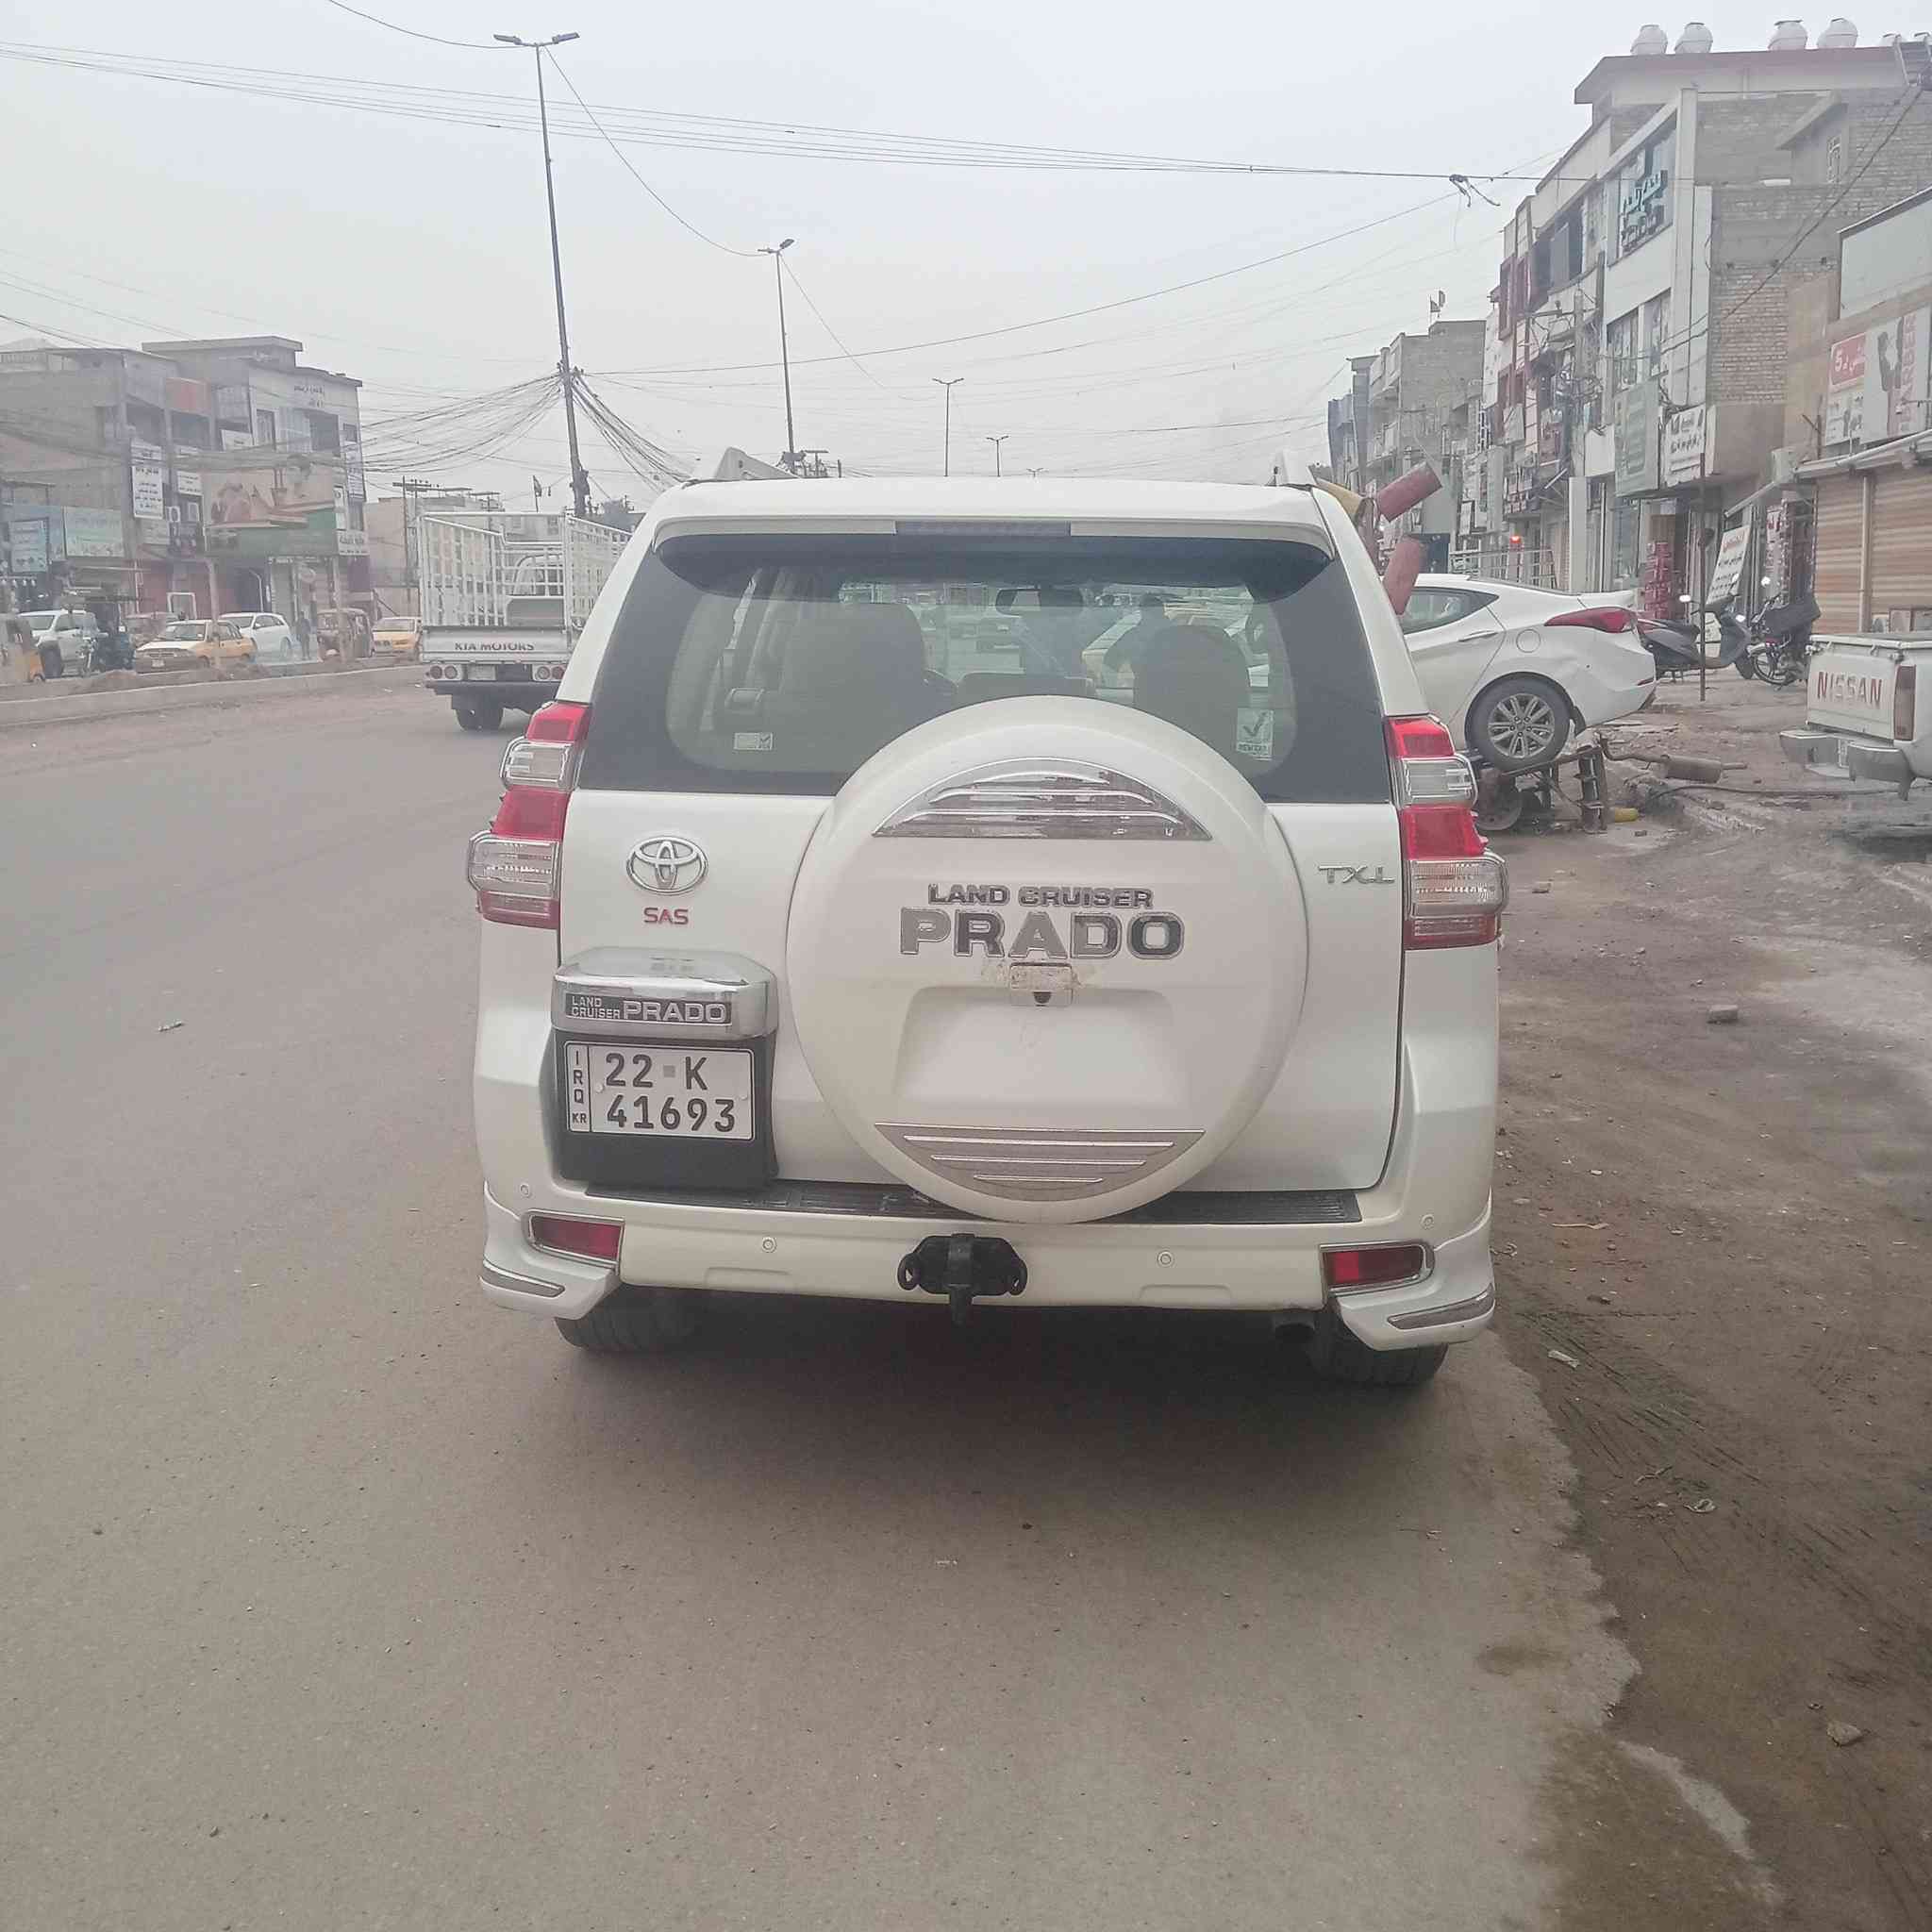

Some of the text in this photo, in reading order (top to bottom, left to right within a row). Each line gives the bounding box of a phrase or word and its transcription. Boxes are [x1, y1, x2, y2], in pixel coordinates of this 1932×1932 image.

[455, 641, 535, 651] KIA MOTORS
[1817, 671, 1883, 706] NISSAN
[927, 883, 1154, 909] LAND CRUISER
[643, 908, 690, 925] SAS
[900, 907, 1186, 960] PRADO
[572, 995, 602, 1008] LAND
[572, 1006, 621, 1020] CRUISER
[623, 1000, 726, 1024] PRADO
[605, 1052, 708, 1091] 22 K
[572, 1112, 587, 1124] KR
[607, 1094, 735, 1133] 41693
